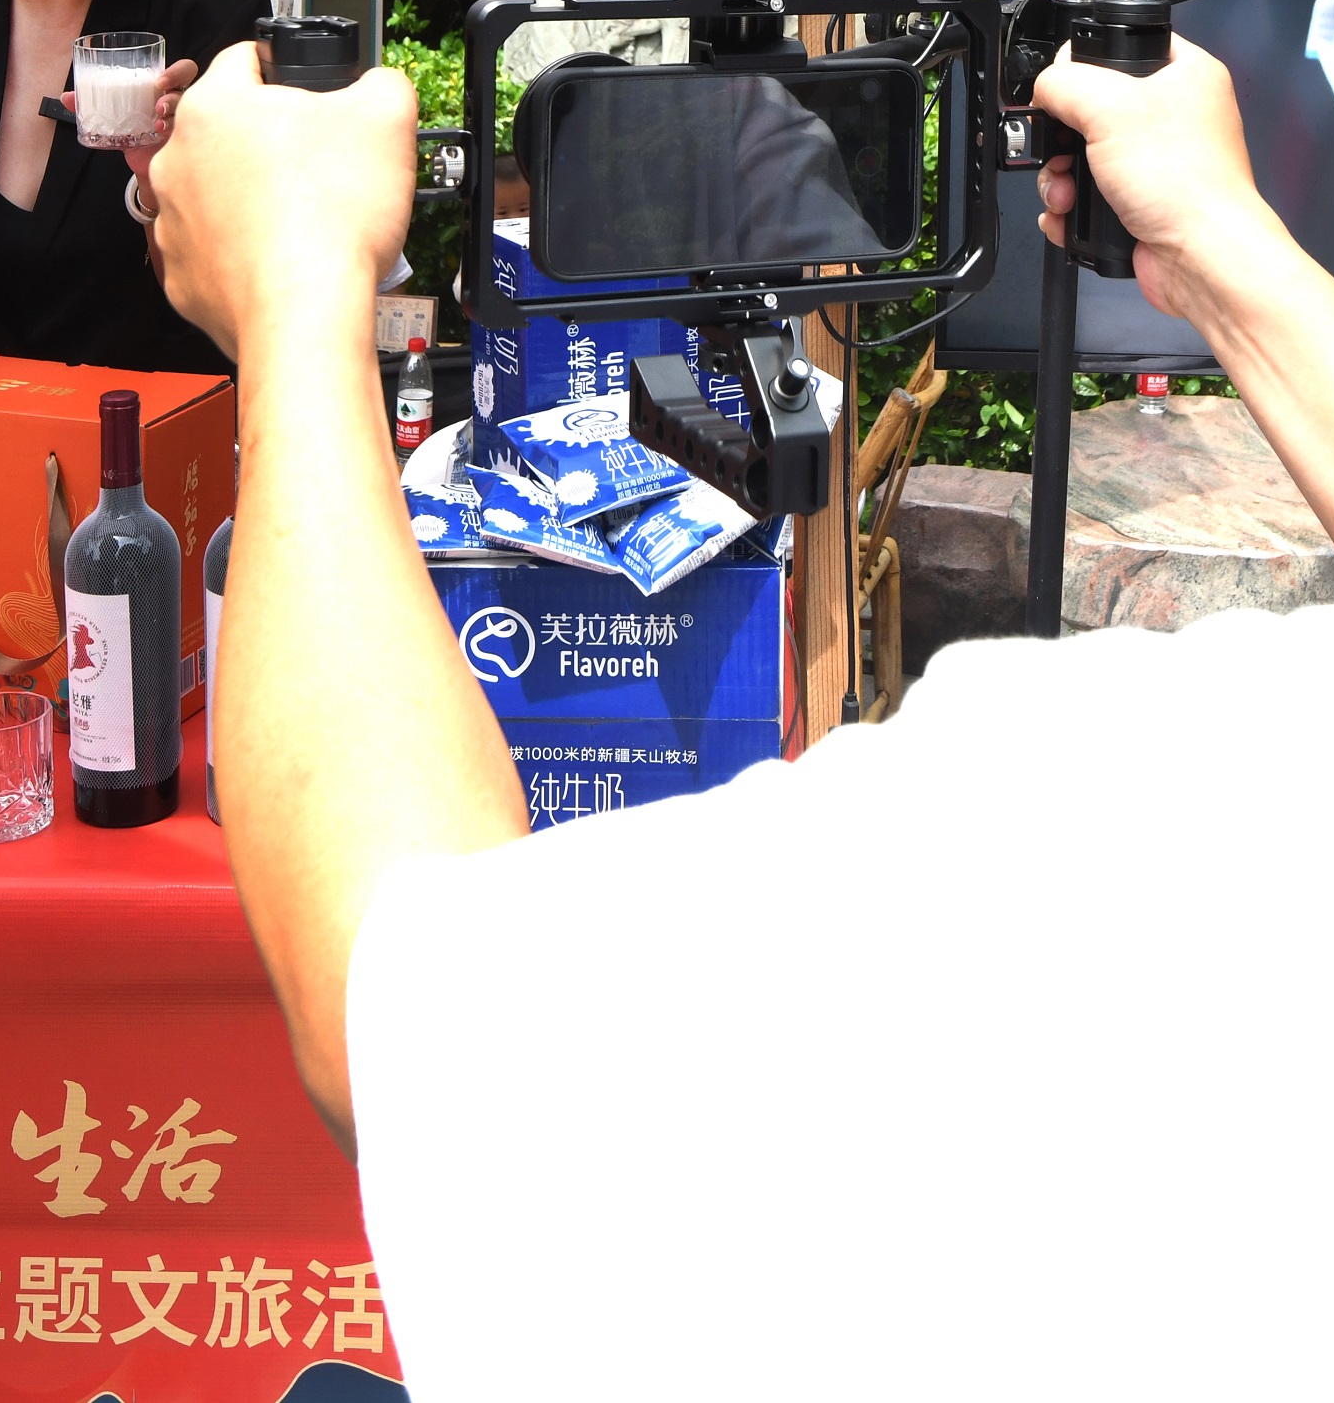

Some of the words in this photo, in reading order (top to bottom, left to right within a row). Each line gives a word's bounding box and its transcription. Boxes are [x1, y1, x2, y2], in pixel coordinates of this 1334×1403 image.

[614, 469, 676, 492] 源自海拔1000米的
[540, 612, 695, 646] 芙拉薇赫®
[560, 650, 659, 678] Flavoreh
[529, 772, 625, 827] 纯牛奶
